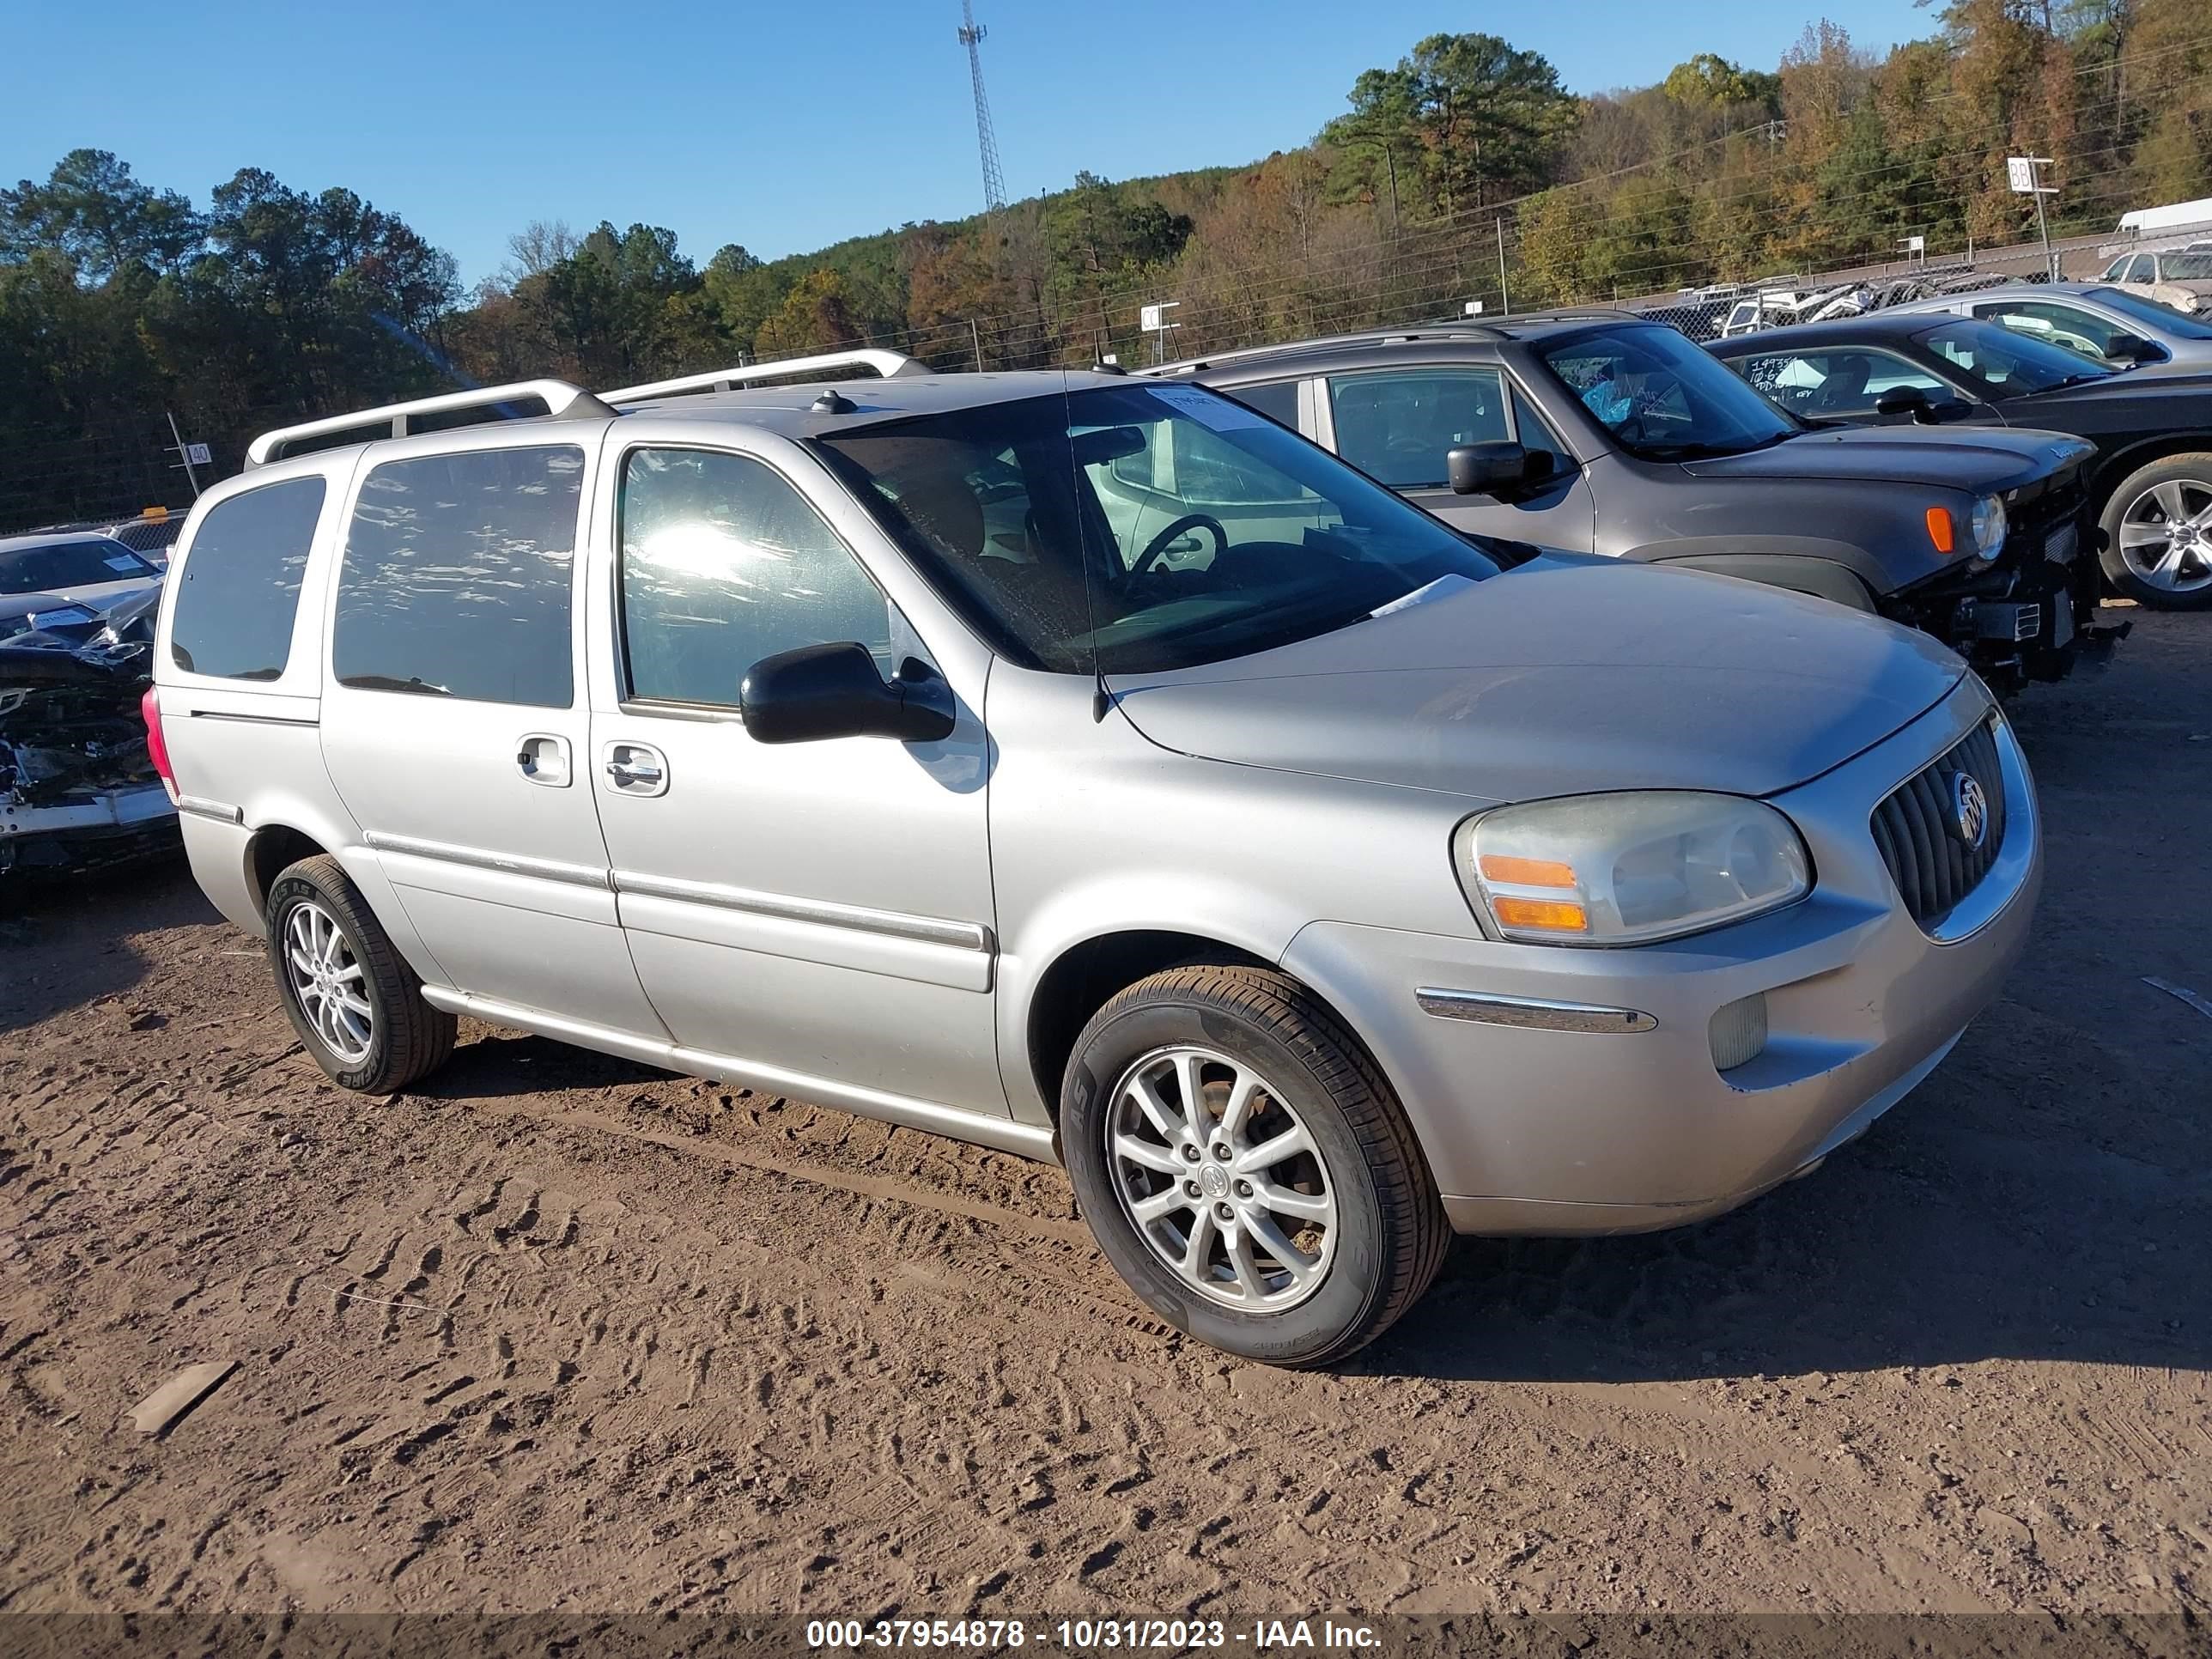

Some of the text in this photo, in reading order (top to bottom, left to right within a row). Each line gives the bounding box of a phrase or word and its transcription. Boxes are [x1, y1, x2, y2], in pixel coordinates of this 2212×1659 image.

[2010, 163, 2030, 187] BB
[1143, 309, 1158, 328] CC
[193, 446, 208, 461] 40
